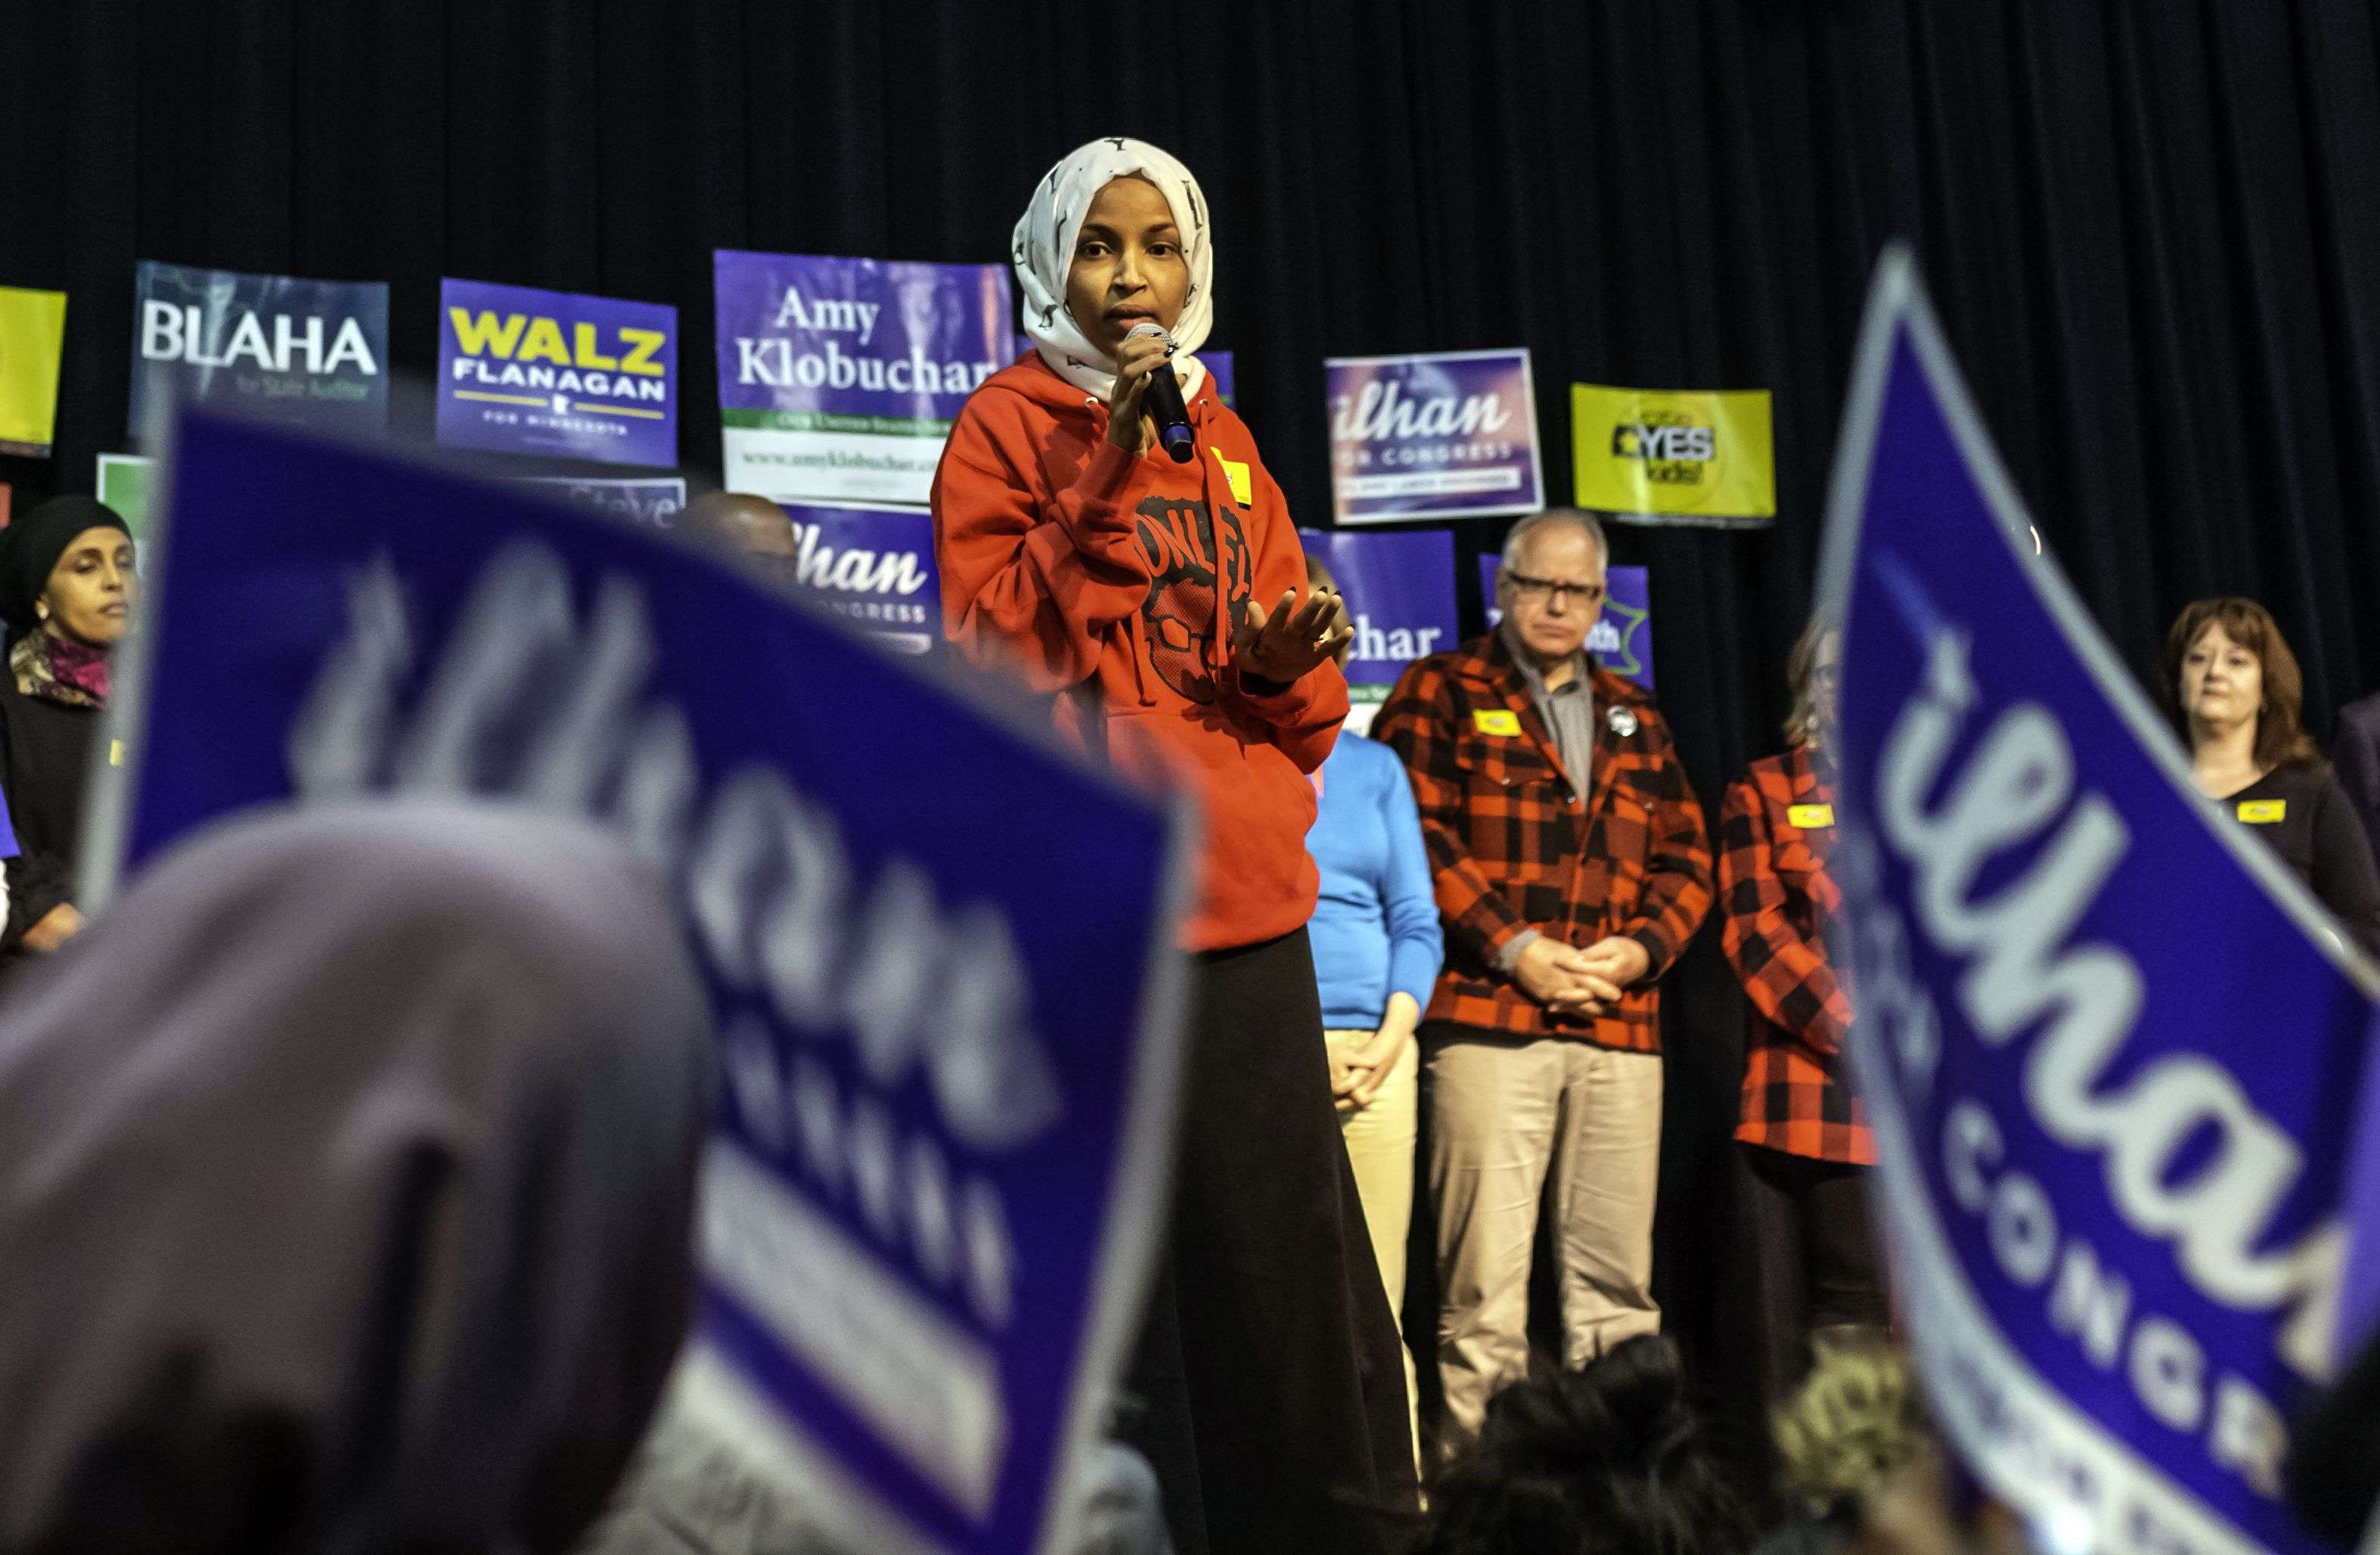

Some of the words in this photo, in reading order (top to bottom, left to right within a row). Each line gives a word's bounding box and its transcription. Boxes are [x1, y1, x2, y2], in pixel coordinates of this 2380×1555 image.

[141, 300, 377, 376] BLAHA
[448, 306, 666, 377] WALZ
[774, 285, 881, 346] Amy
[452, 357, 666, 402] FLANAGAN
[736, 337, 998, 394] Klobuchar
[482, 410, 519, 425] FOR
[526, 414, 628, 436] MINNESOTA
[1333, 380, 1513, 442] ilhan
[1382, 442, 1513, 466] CONGRESS
[1634, 426, 1714, 461] YES
